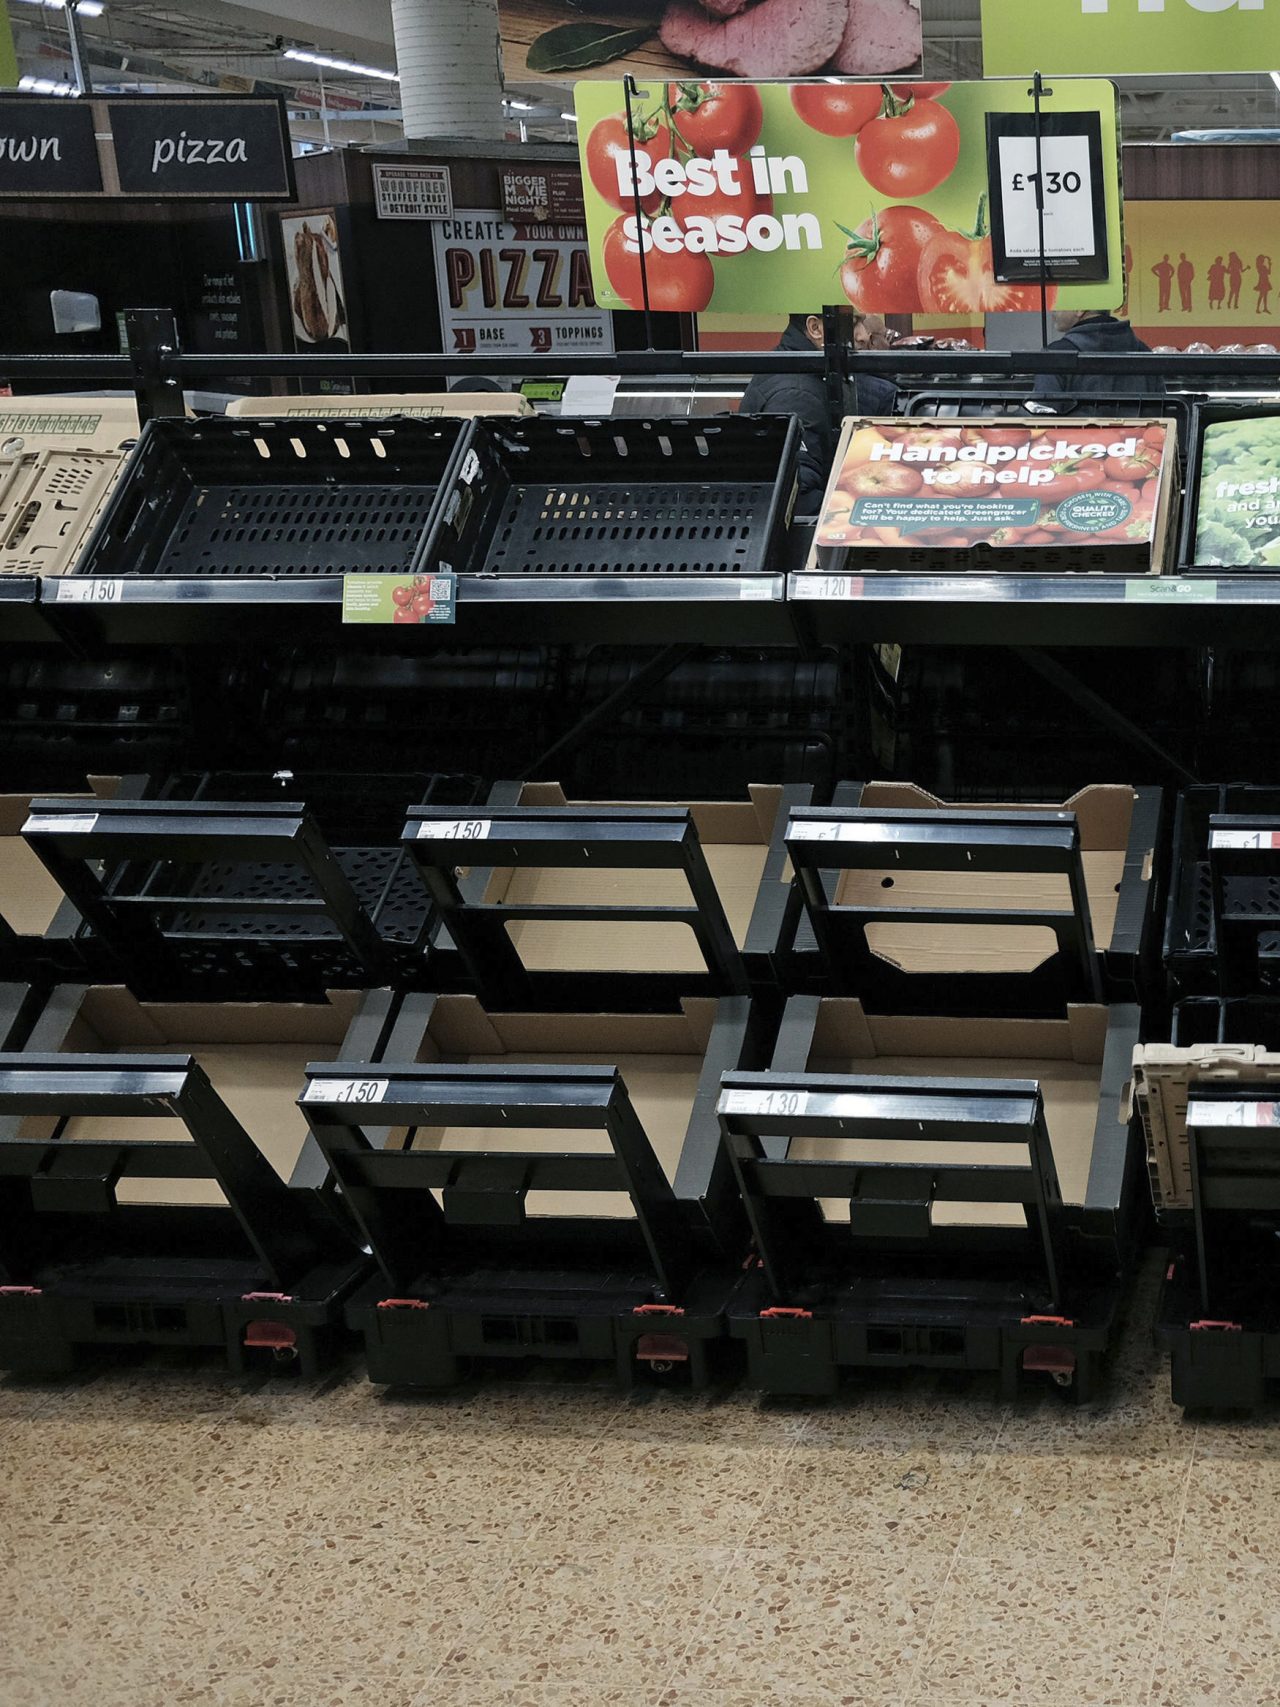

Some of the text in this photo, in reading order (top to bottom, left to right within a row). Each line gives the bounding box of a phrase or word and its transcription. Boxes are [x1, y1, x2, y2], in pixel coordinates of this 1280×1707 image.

[151, 131, 248, 173] pizza
[615, 145, 809, 197] Best in
[380, 180, 446, 193] WOODFIRED
[503, 175, 546, 185] BIGGER
[504, 185, 547, 197] MVIE
[381, 193, 446, 203] STUFFED CRUST
[505, 196, 548, 206] NIGHTS
[389, 204, 421, 214] DETROIT
[424, 205, 448, 215] STYLE
[442, 220, 584, 240] CREATE YOUR OWN
[625, 212, 823, 254] season
[445, 248, 598, 310] PIZZA
[461, 331, 467, 346] 1
[479, 328, 505, 340] BASE
[538, 329, 545, 345] 3
[555, 327, 603, 339] TOPPINGS
[869, 438, 1138, 463] Handpicked
[921, 466, 1056, 486] to help
[942, 502, 974, 511] you're
[976, 502, 1014, 511] looking
[963, 509, 1027, 517] Greengrocer
[1227, 501, 1260, 513] and
[895, 515, 927, 523] happy
